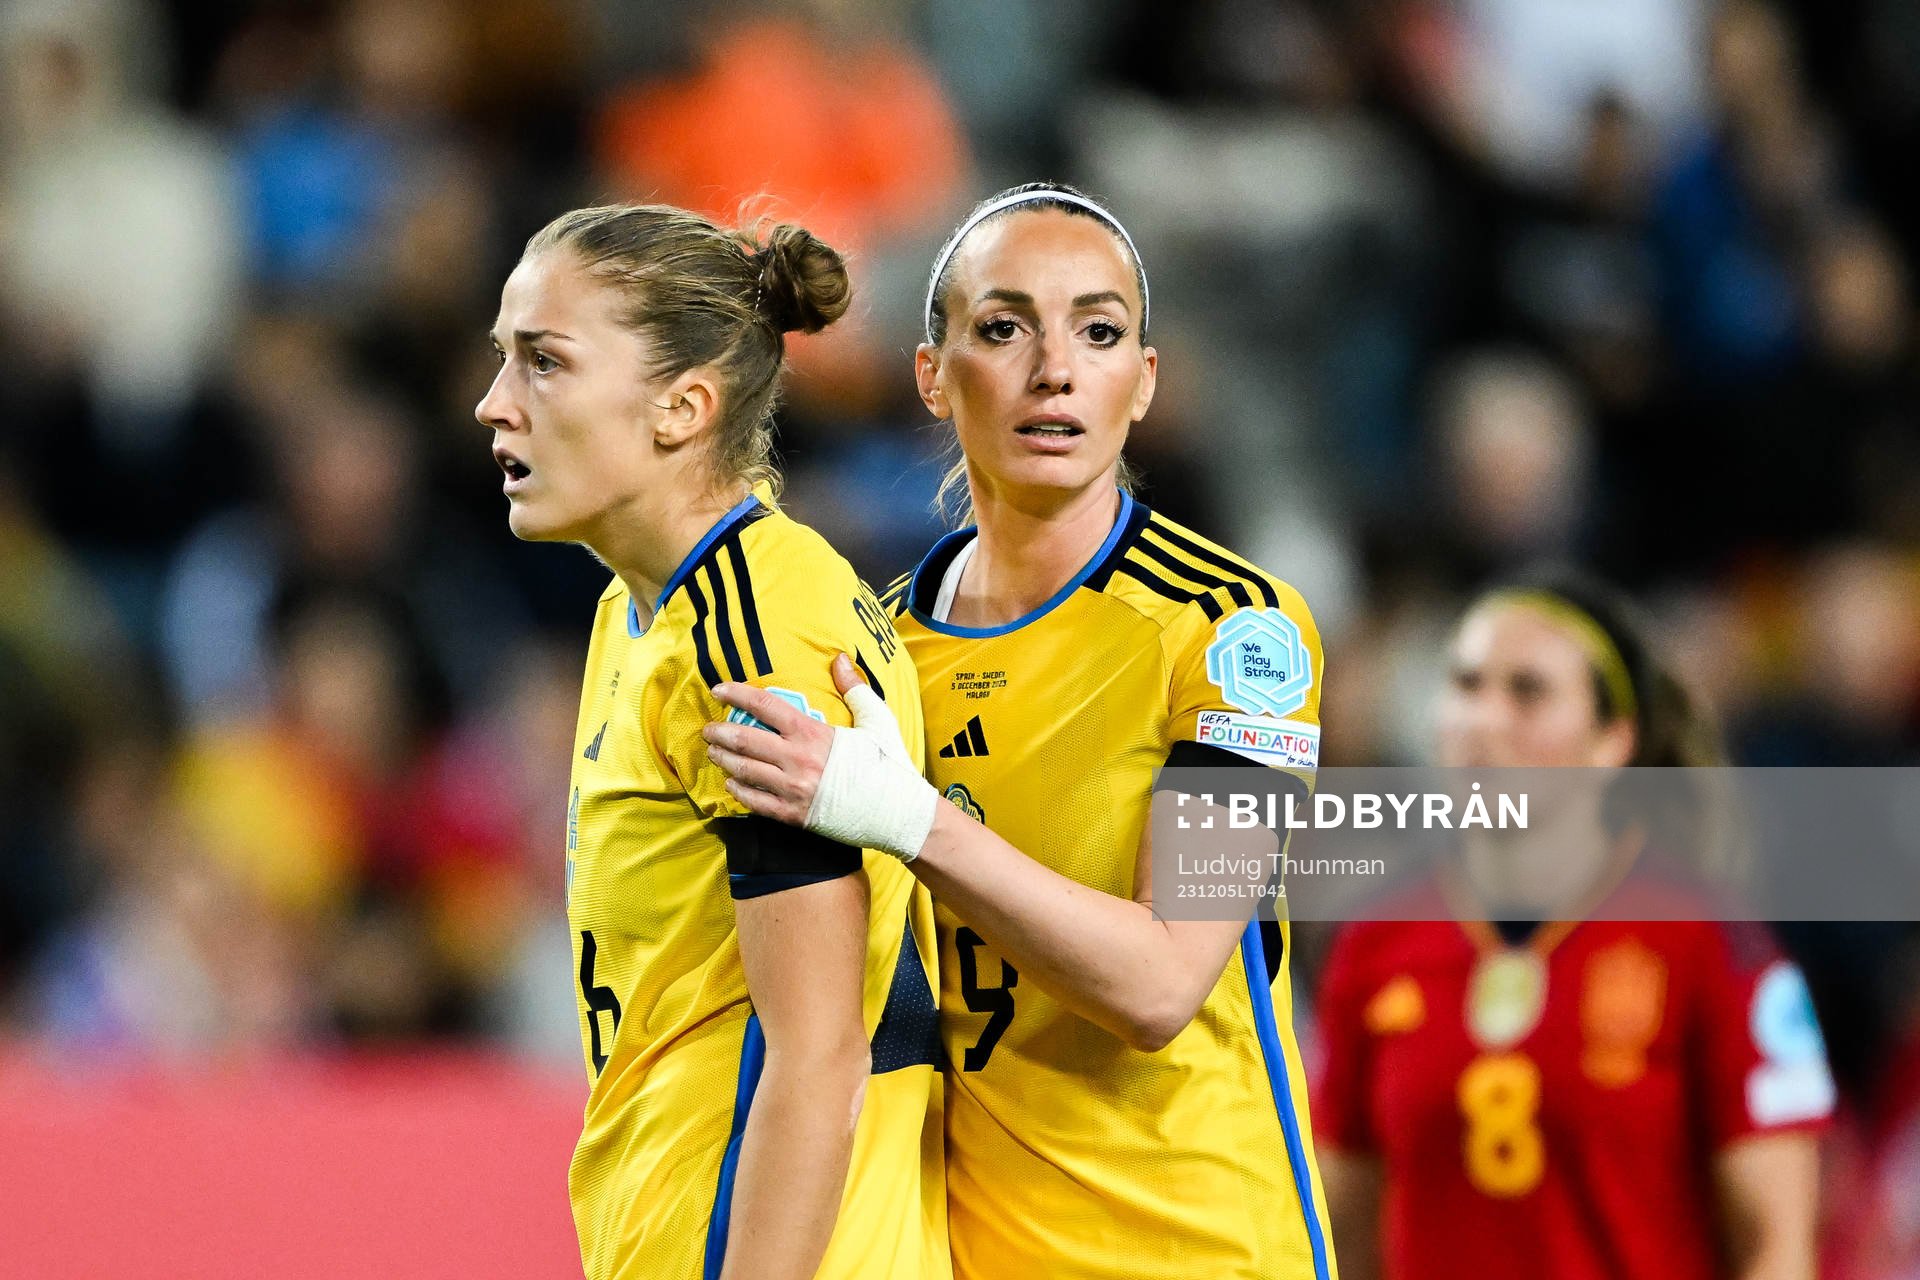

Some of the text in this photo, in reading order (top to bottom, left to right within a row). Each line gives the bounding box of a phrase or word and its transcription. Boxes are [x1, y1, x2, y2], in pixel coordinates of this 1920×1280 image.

[1242, 643, 1261, 653] We
[1243, 655, 1271, 669] Play
[982, 671, 1006, 679] SWEDEN
[1245, 667, 1285, 682] Strong
[992, 680, 1007, 688] 2023
[966, 691, 990, 699] MALAGA
[1201, 713, 1231, 726] UEFA
[580, 930, 622, 1079] 6
[955, 926, 1018, 1073] 9
[1457, 1051, 1546, 1199] 8
